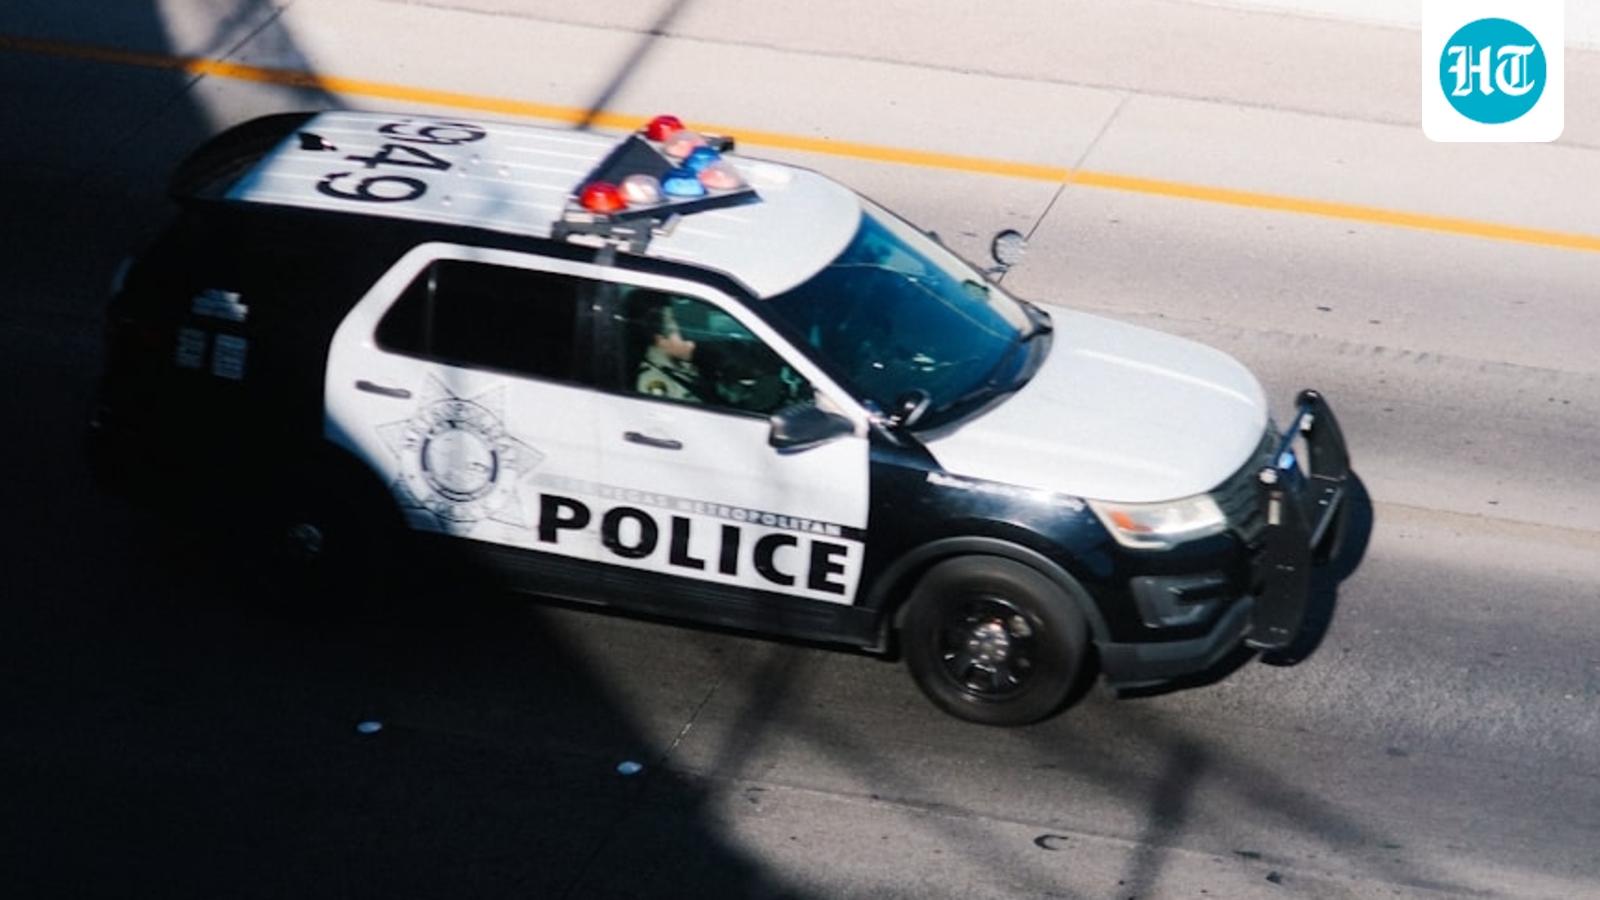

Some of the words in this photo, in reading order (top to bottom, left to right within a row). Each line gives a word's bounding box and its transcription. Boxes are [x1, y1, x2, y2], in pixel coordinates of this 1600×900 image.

[316, 120, 487, 203] 949
[538, 493, 849, 595] POLICE
[676, 498, 842, 537] METROPOLITAN
